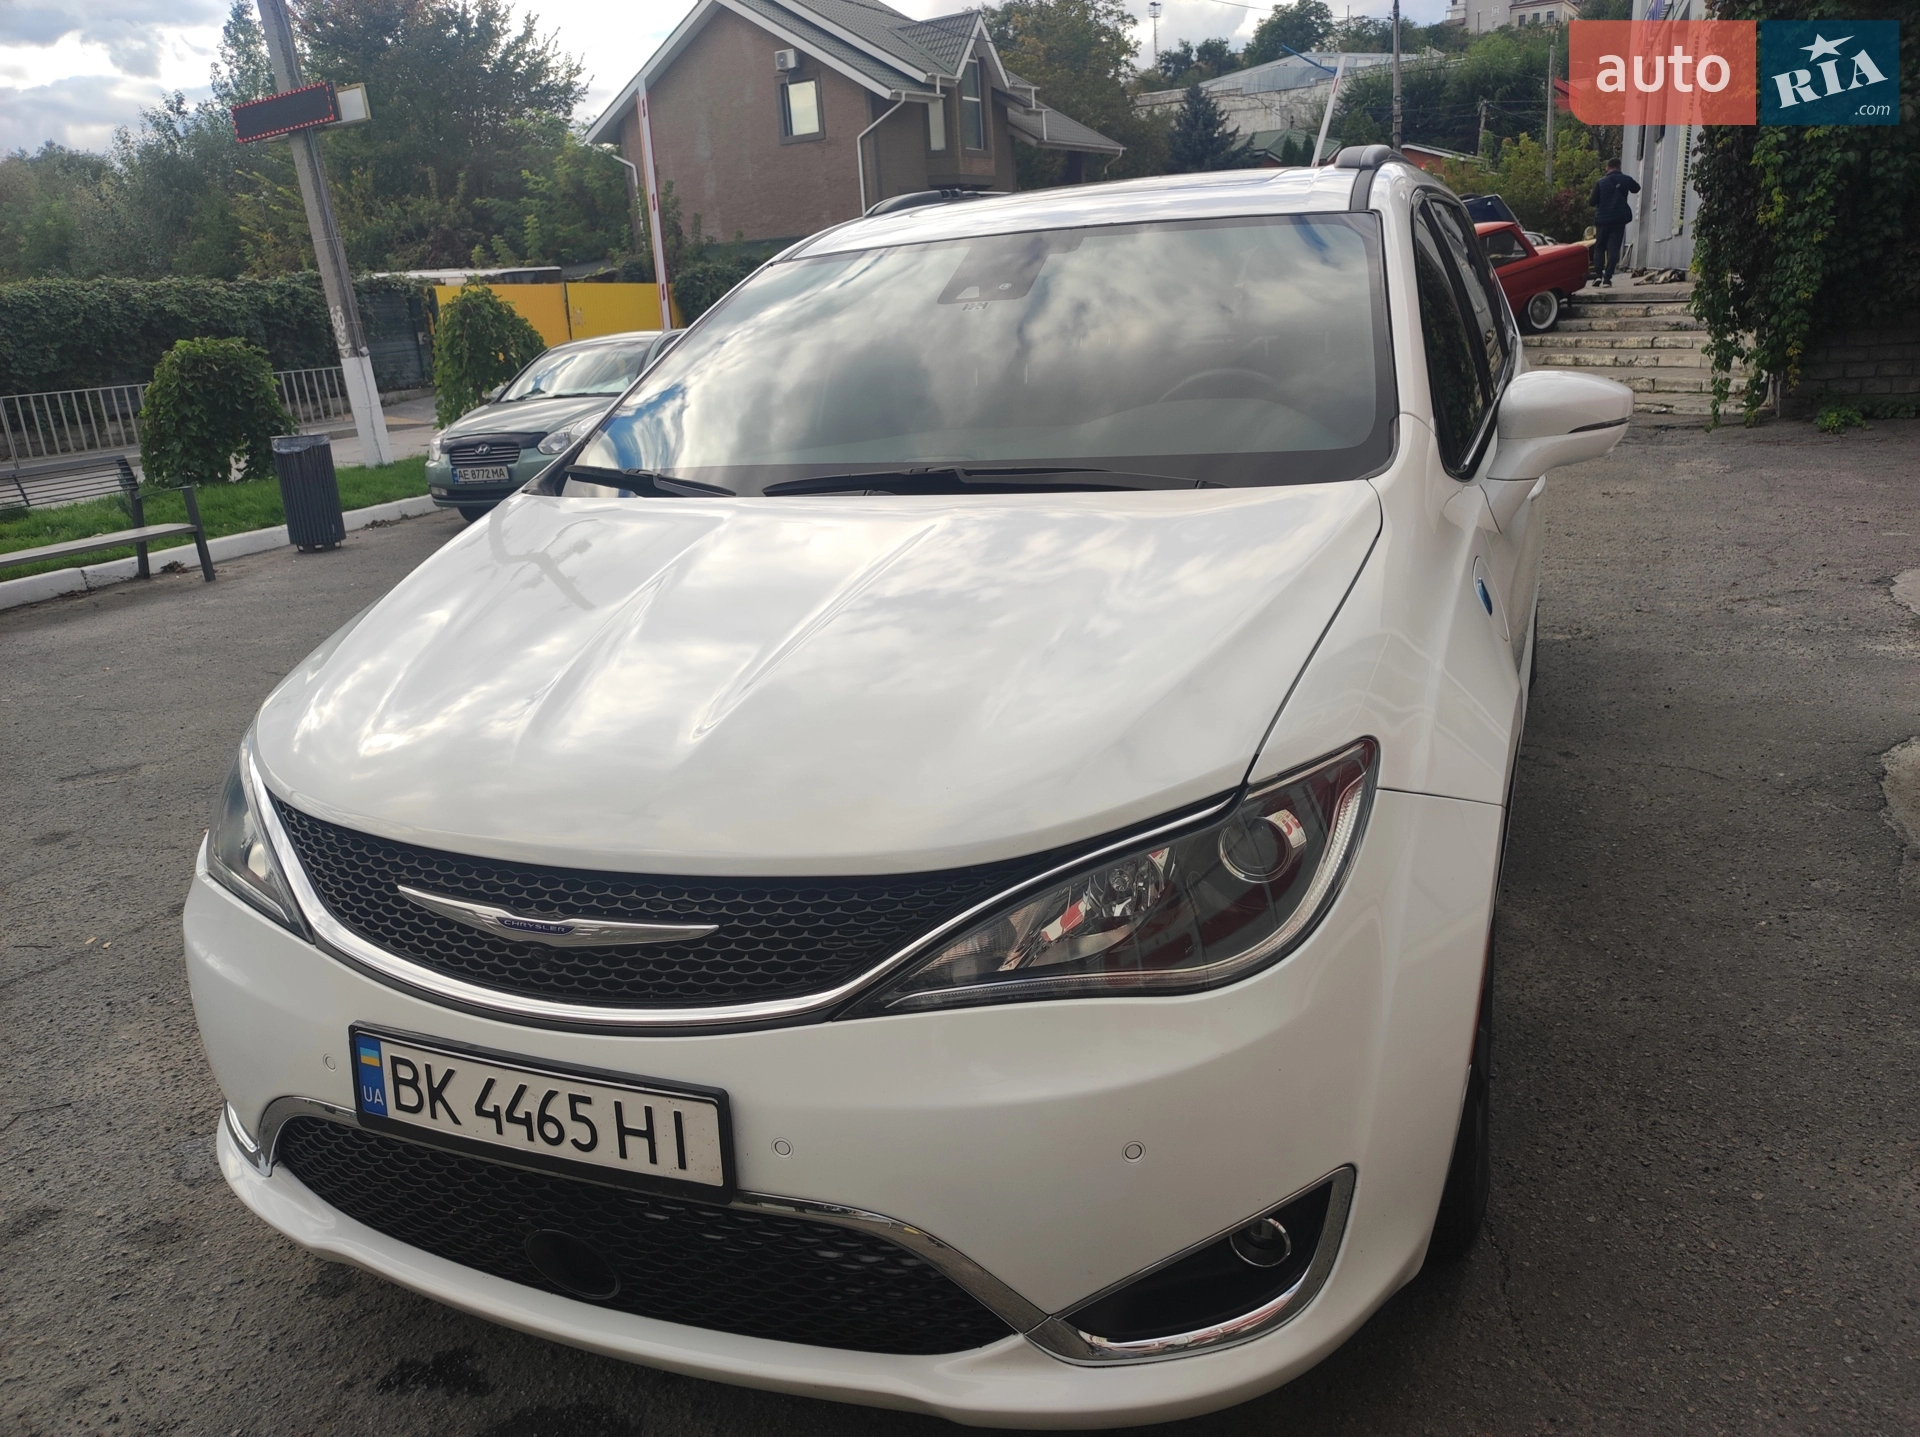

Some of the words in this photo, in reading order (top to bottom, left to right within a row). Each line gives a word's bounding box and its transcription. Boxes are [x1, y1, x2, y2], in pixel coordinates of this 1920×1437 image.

[458, 469, 470, 480] AE
[471, 468, 491, 480] 8772
[491, 467, 506, 479] MA
[504, 920, 565, 933] CHRYSLER
[363, 1086, 384, 1106] UA
[390, 1054, 461, 1126] BK
[475, 1077, 598, 1153] 4465
[614, 1100, 687, 1171] HI
